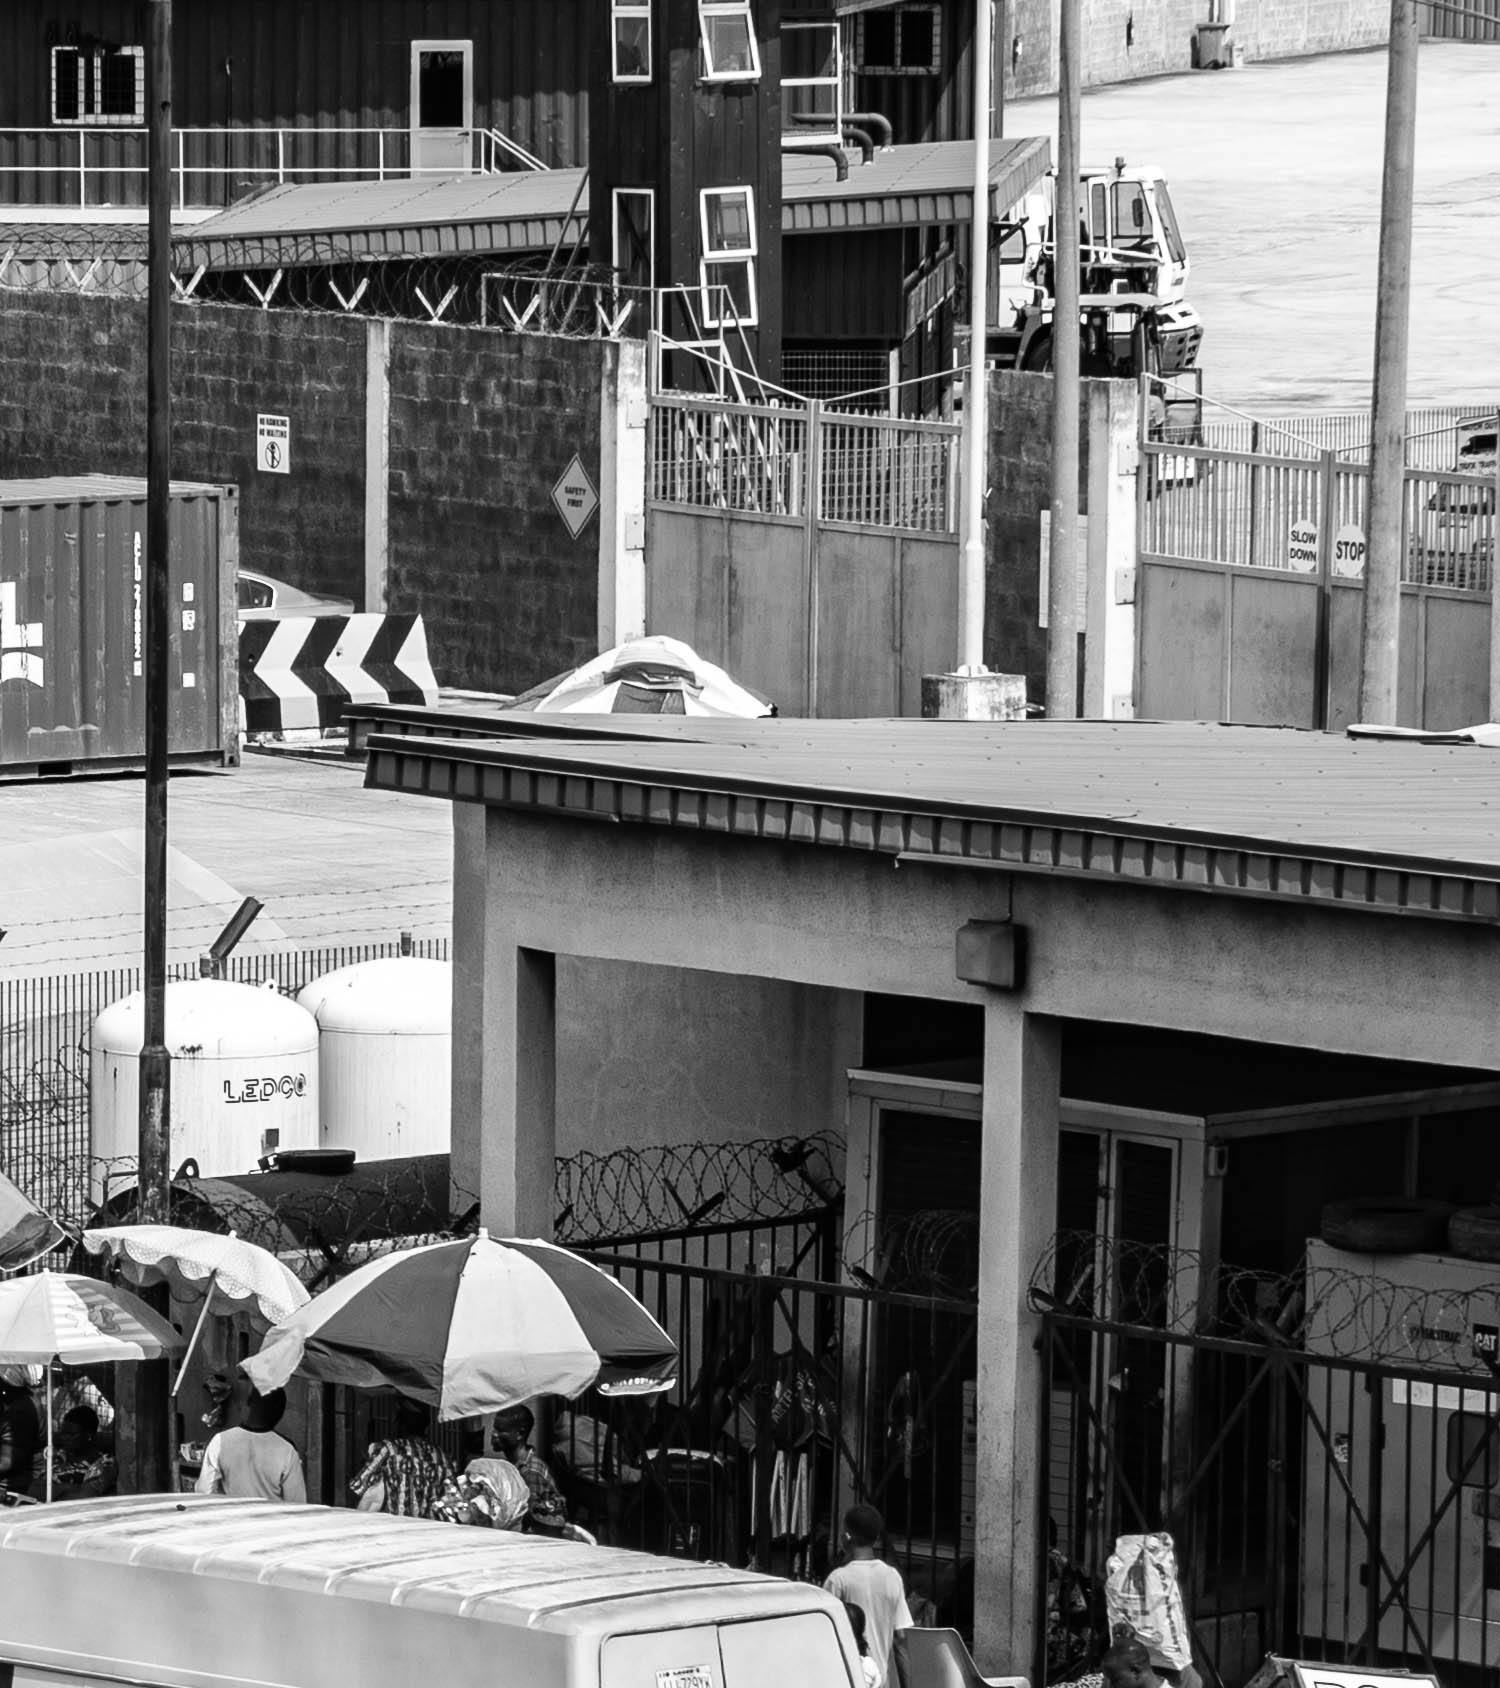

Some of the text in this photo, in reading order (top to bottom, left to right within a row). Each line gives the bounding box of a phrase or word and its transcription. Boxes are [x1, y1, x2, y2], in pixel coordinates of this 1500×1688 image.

[1291, 530, 1317, 544] SLOW
[1290, 548, 1317, 562] DOWN
[1336, 541, 1365, 561] STOP
[1475, 1335, 1497, 1351] CAT
